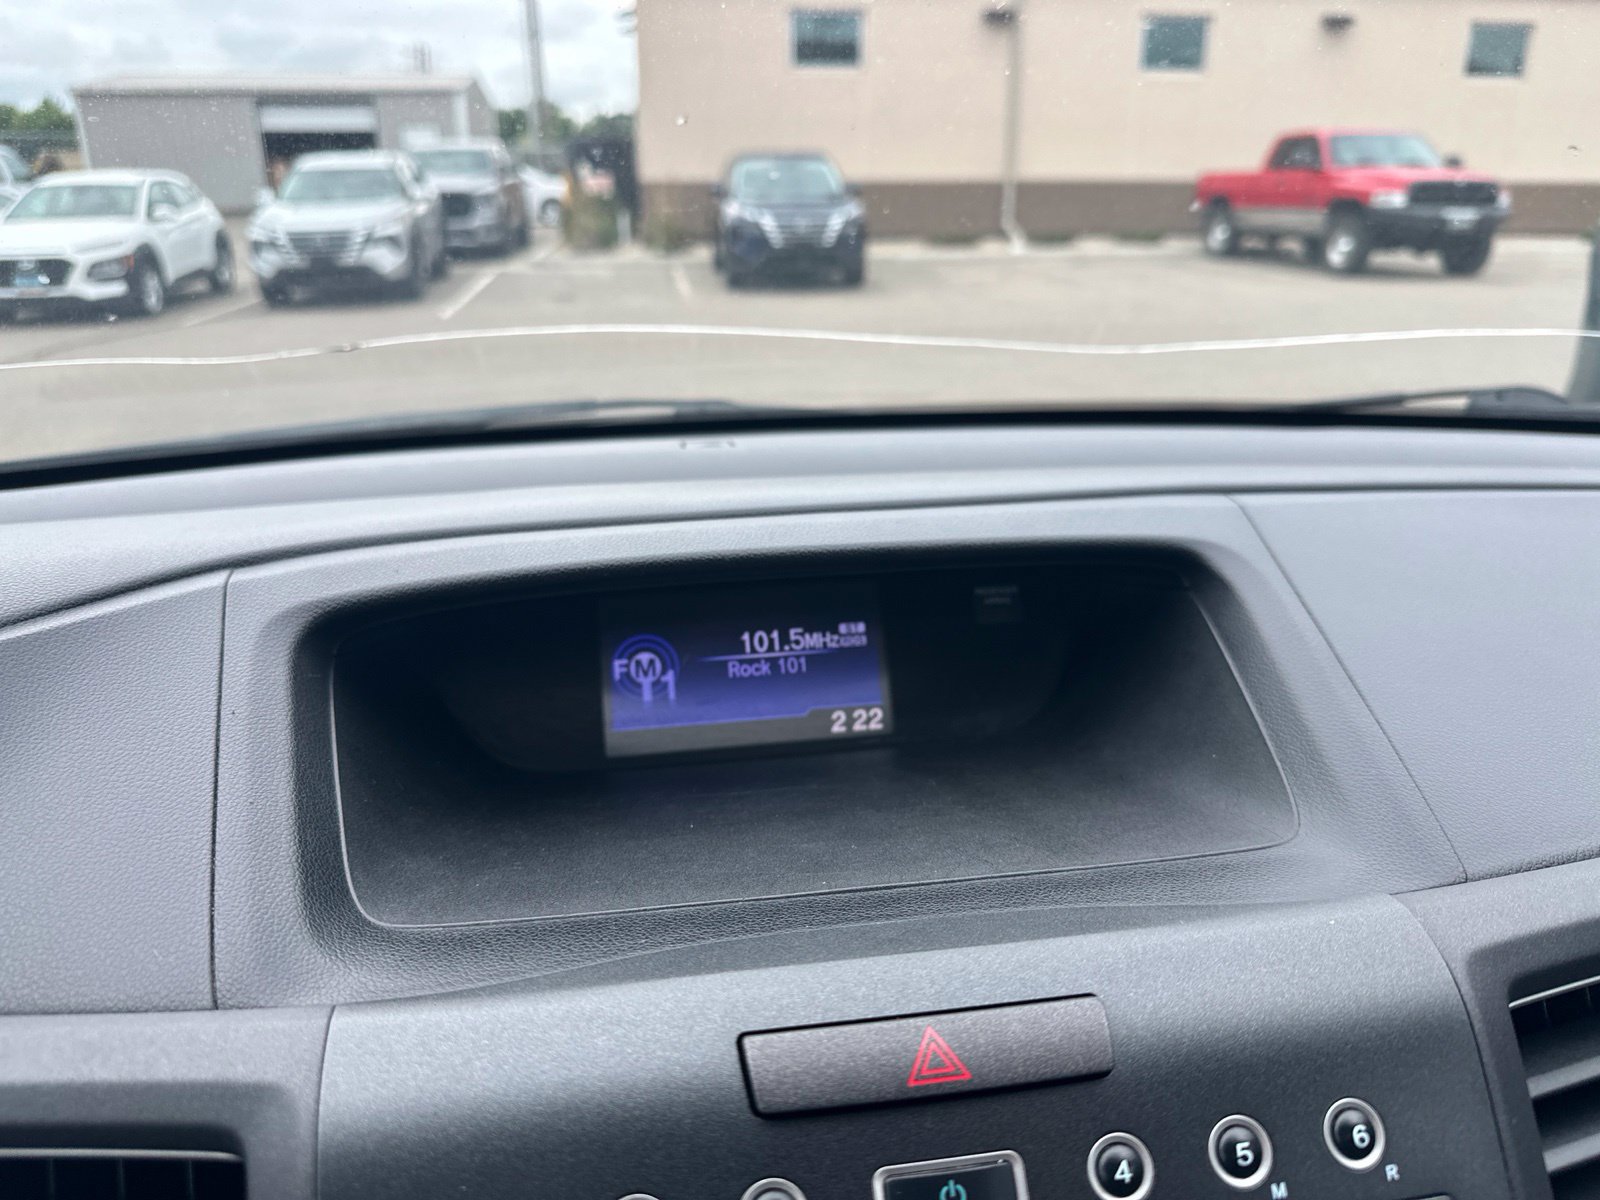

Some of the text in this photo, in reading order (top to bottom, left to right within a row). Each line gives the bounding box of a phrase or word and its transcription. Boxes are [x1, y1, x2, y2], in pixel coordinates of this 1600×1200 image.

[728, 656, 807, 678] Rock 101
[1352, 1124, 1371, 1149] 6
[1235, 1141, 1255, 1167] 5
[1114, 1159, 1134, 1184] 4
[1385, 1163, 1400, 1182] R
[1270, 1181, 1288, 1200] M
